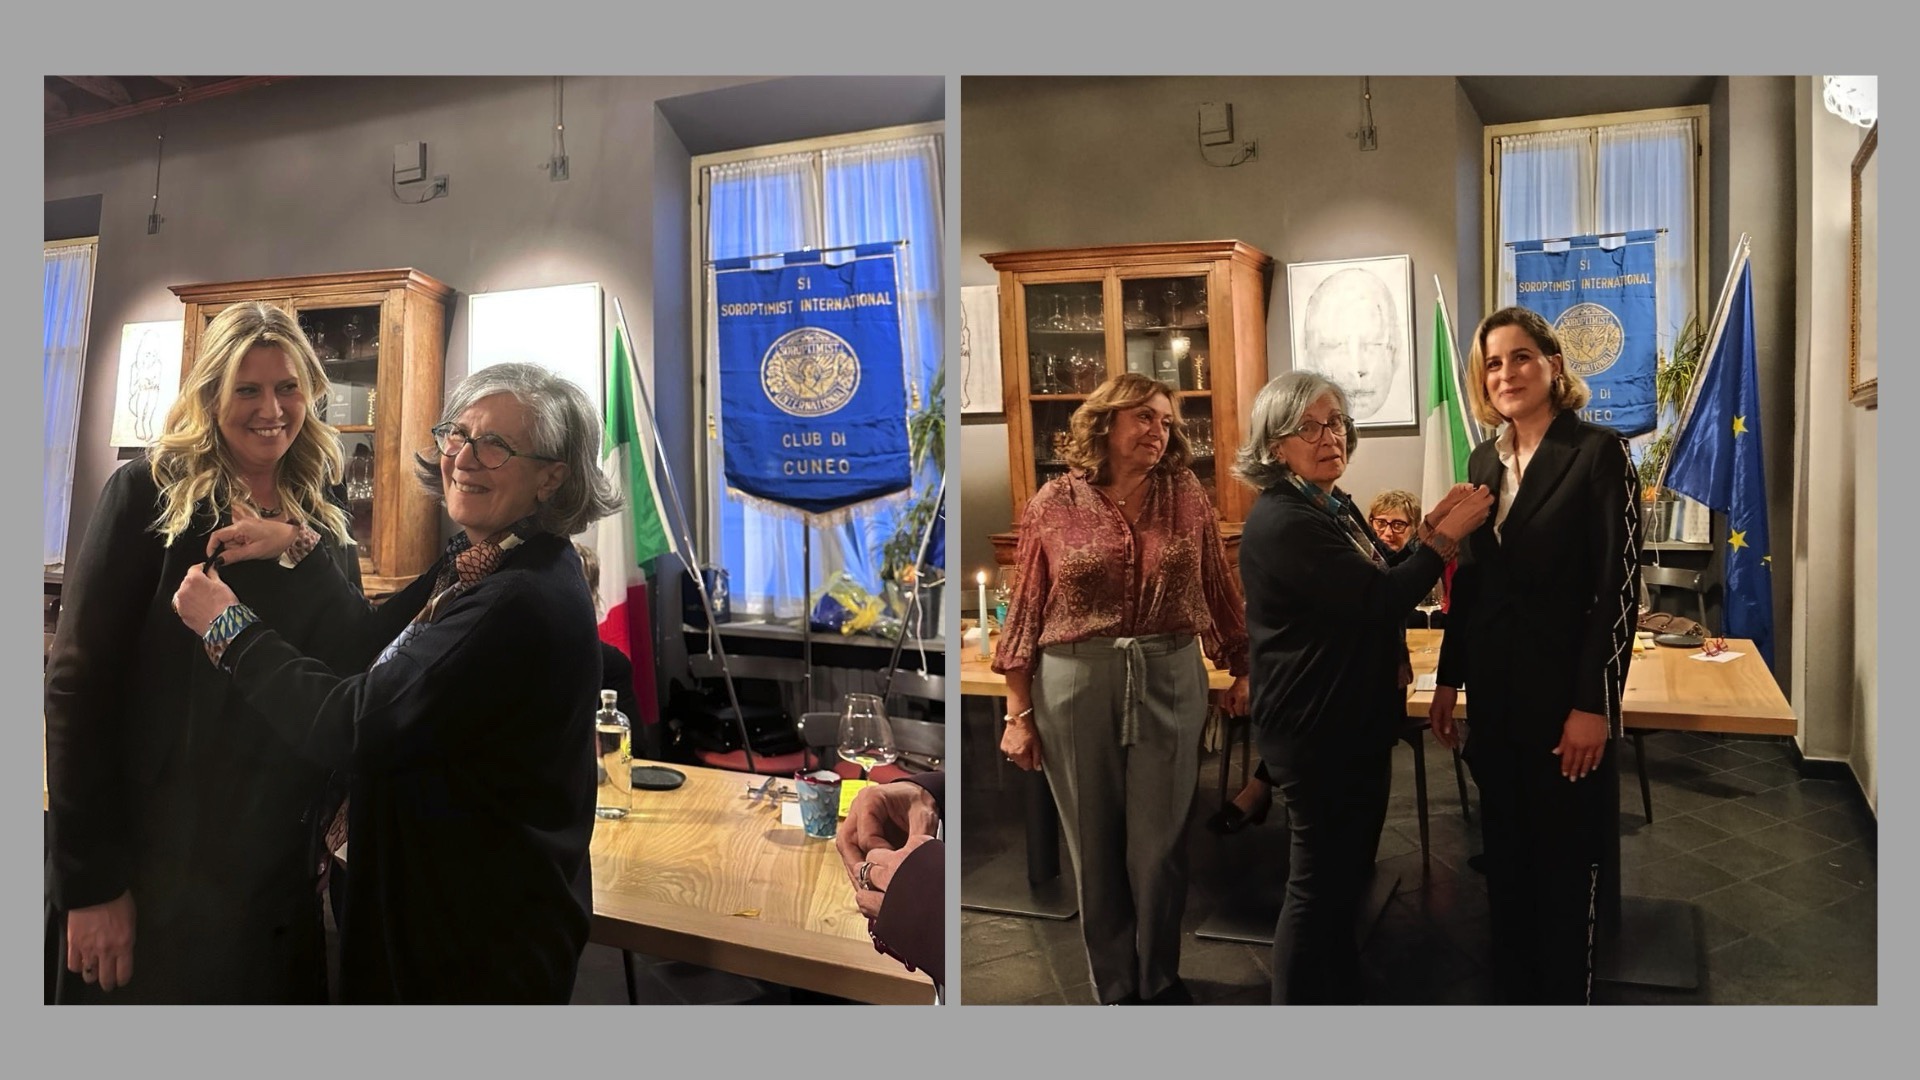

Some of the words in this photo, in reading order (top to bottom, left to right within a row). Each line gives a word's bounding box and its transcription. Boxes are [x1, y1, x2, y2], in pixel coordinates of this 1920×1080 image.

[1580, 259, 1590, 271] SI
[797, 277, 811, 290] SI
[1519, 280, 1576, 293] SOROPTIMIST
[1581, 273, 1652, 290] INTERNATIONAL
[721, 301, 793, 317] SOROPTIMIST
[800, 291, 893, 312] INTERNATIONAL
[1600, 388, 1611, 400] DI
[1579, 409, 1612, 422] NEO
[782, 432, 823, 448] CLUB
[831, 432, 847, 446] DI
[783, 458, 850, 475] CUNEO
